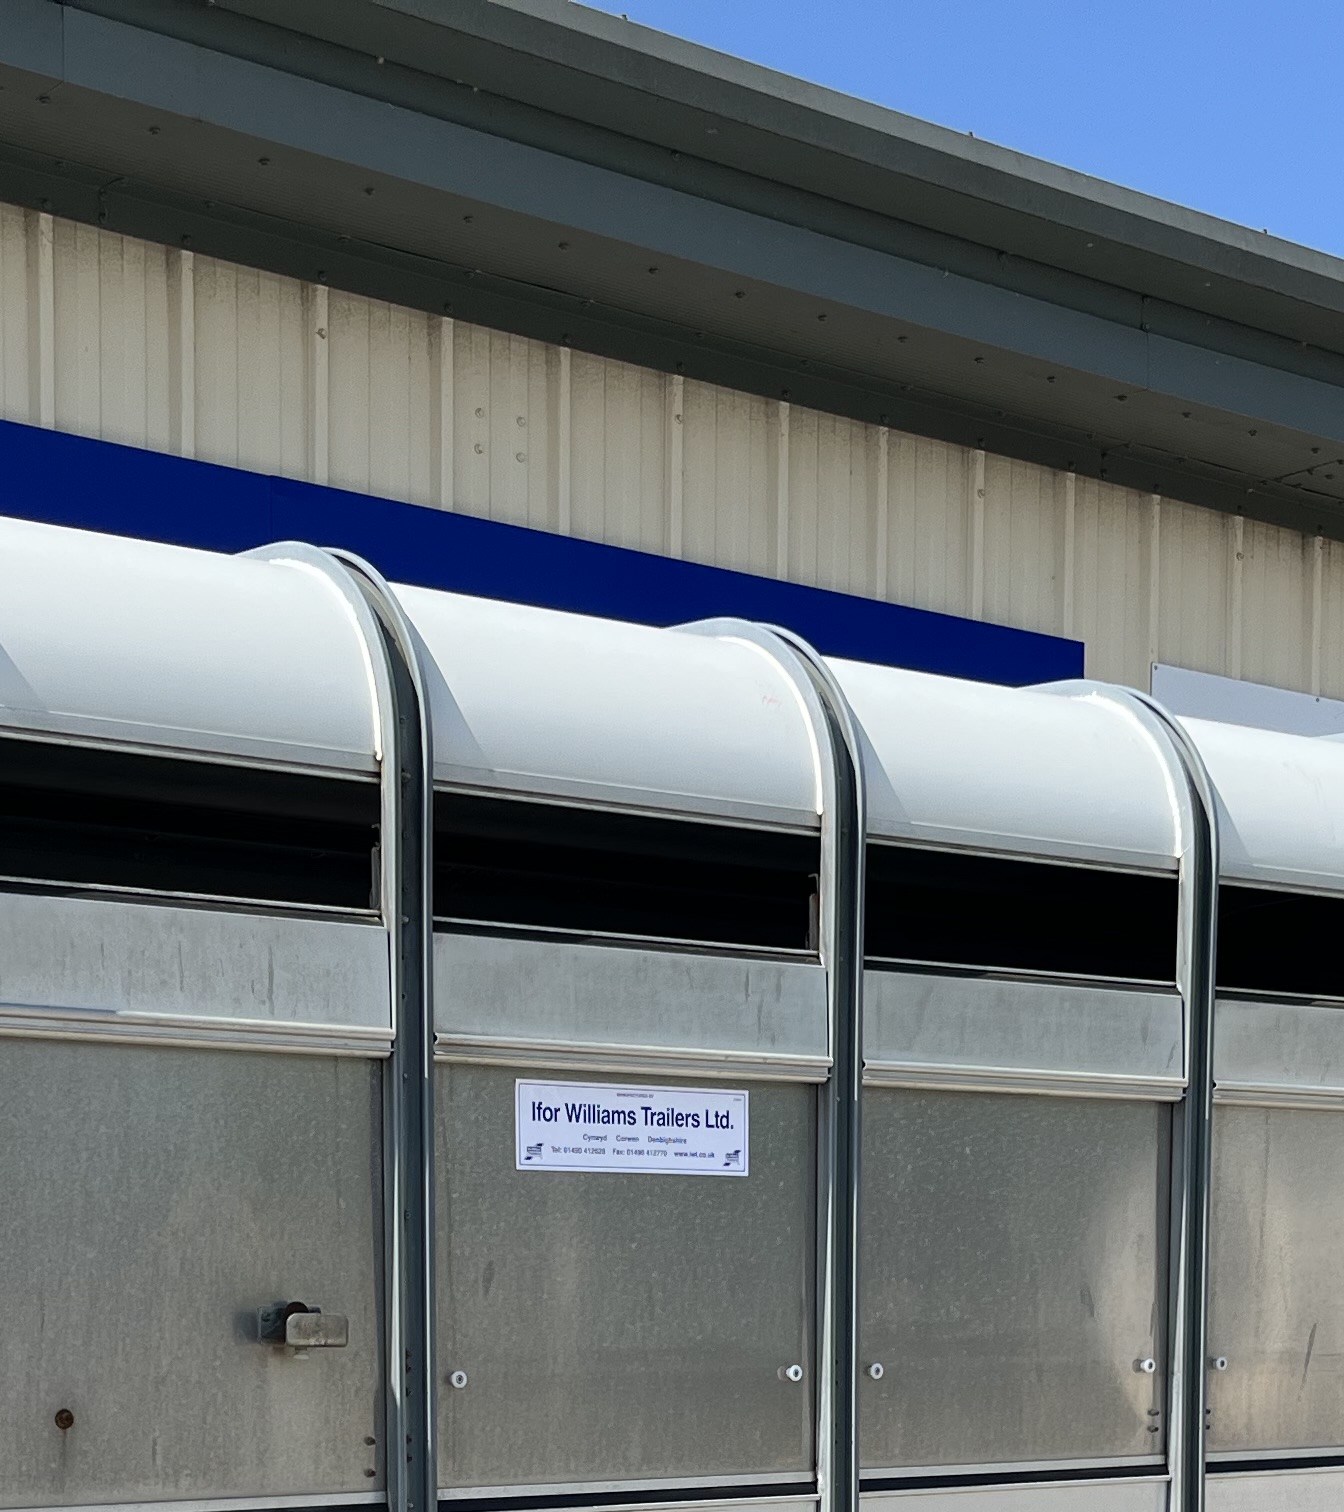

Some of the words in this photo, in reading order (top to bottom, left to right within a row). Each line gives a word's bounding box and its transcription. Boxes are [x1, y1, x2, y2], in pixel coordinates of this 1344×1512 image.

[531, 1101, 560, 1122] Ifor
[564, 1103, 637, 1126] Williams
[640, 1106, 701, 1128] Trailers
[705, 1109, 734, 1130] Ltd.
